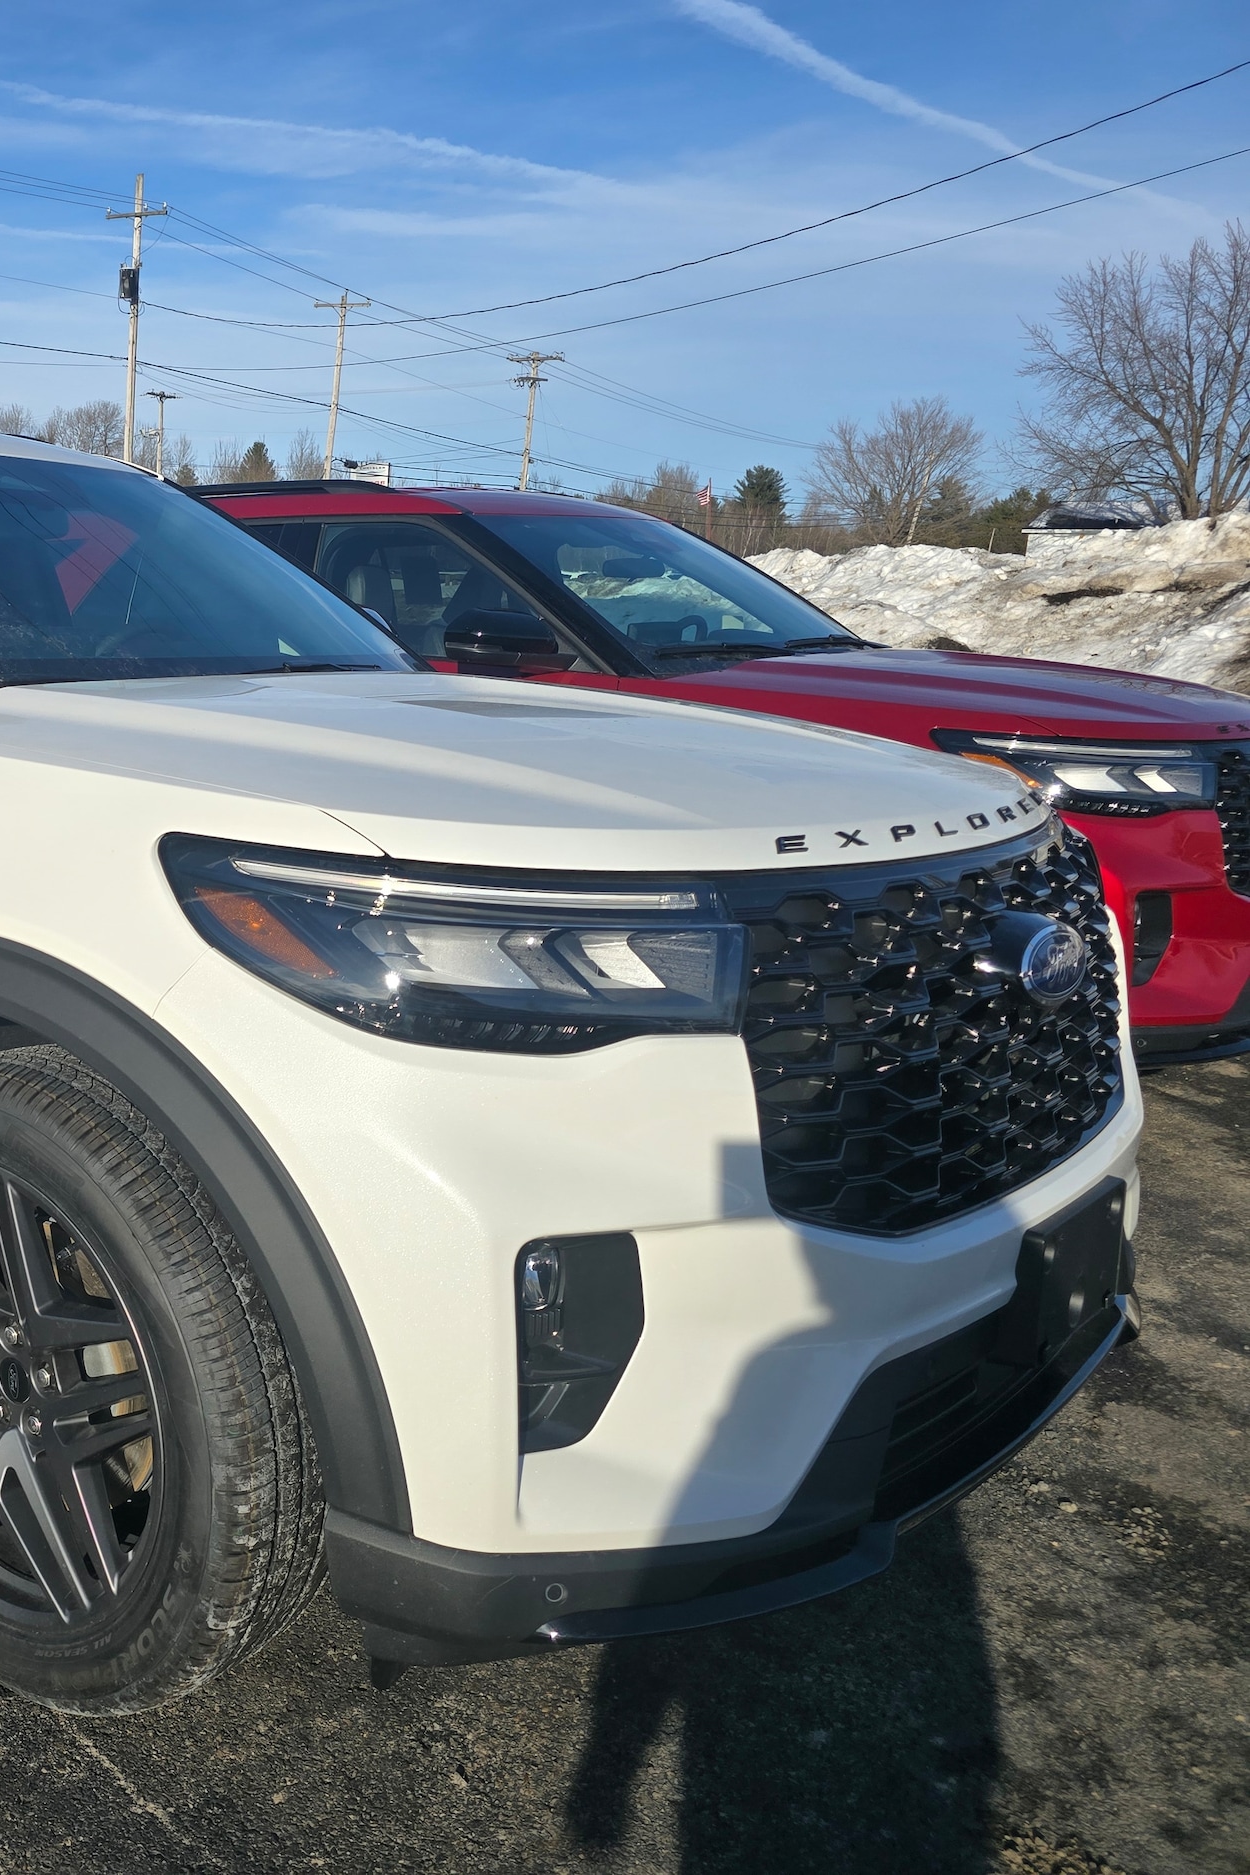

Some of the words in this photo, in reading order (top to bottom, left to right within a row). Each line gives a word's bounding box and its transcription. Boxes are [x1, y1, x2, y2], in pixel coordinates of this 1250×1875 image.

[47, 1581, 184, 1688] SCORPION
[92, 1633, 114, 1649] ALL
[33, 1644, 89, 1657] SEASON
